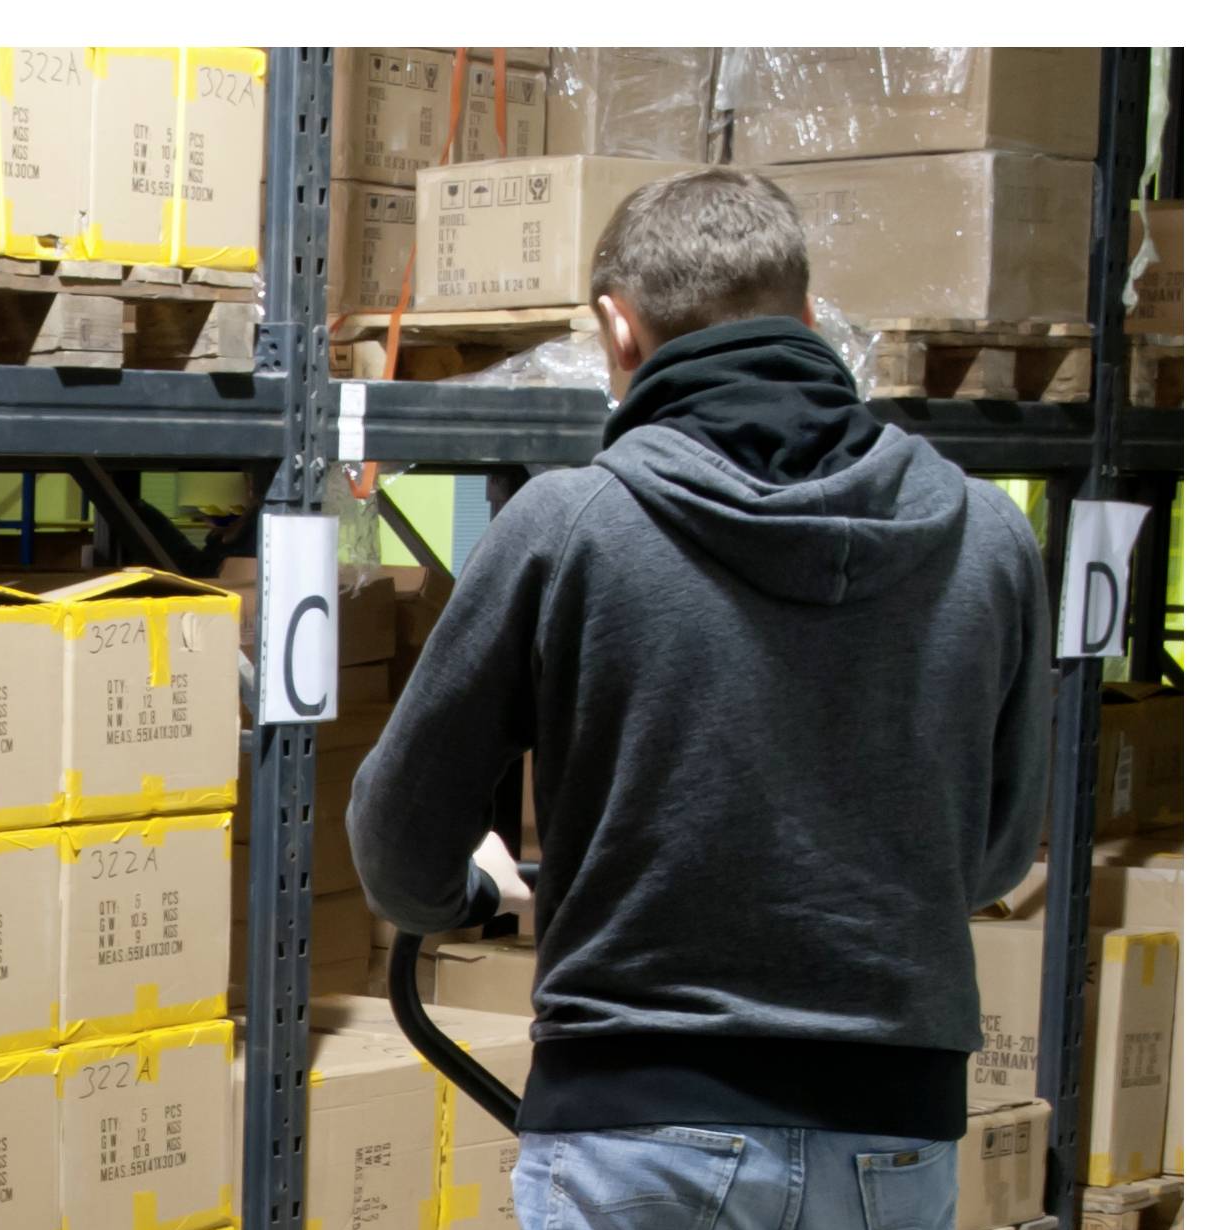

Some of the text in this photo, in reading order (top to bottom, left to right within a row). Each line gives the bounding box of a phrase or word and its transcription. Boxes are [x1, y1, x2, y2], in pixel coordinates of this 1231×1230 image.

[20, 50, 80, 86] 322A
[199, 67, 255, 108] 322A
[12, 105, 29, 123] PCS
[1081, 562, 1119, 654] D
[90, 620, 146, 654] 322A
[283, 595, 329, 716] C
[170, 673, 188, 688] PCS
[91, 847, 157, 879] 322A
[162, 891, 179, 905] PCS
[79, 1056, 151, 1099] 322A
[165, 1104, 182, 1119] PCS
